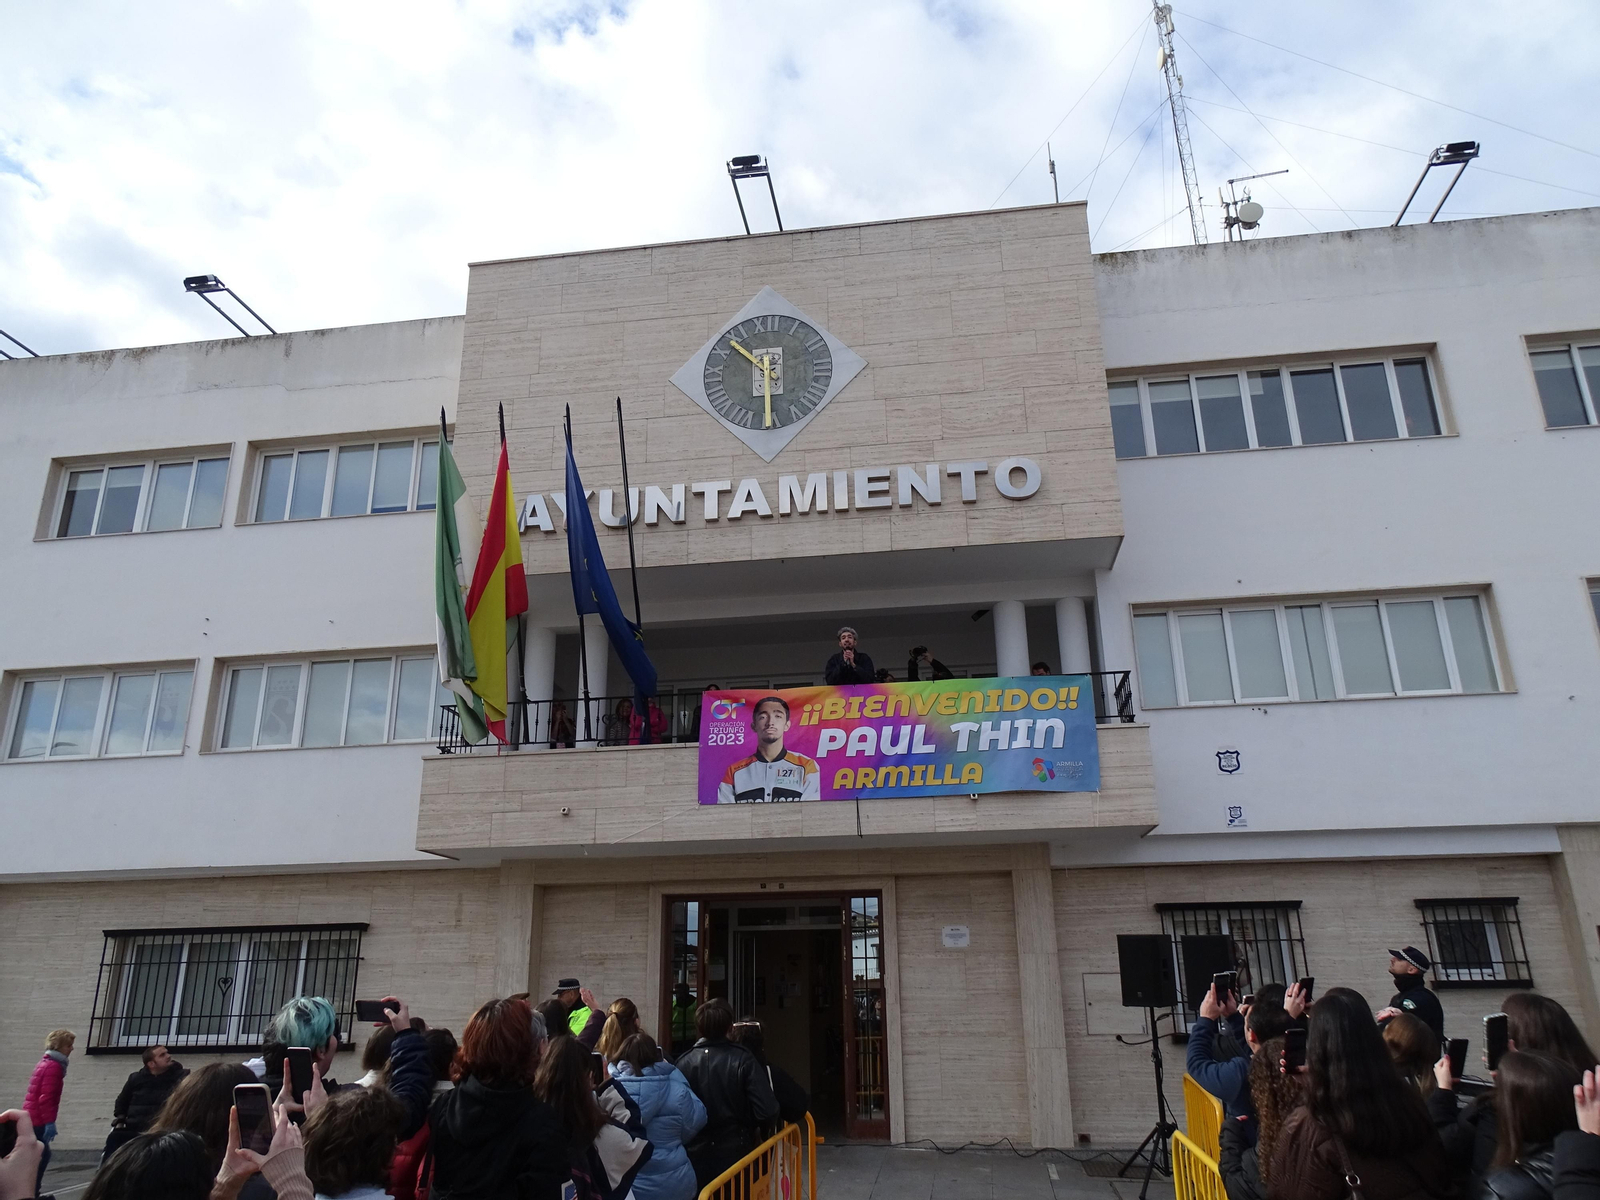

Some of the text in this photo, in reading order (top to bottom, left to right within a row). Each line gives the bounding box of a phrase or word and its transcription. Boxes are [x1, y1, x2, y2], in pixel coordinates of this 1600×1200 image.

[724, 324, 749, 343] XI
[752, 316, 780, 334] XII
[788, 320, 801, 335] I
[711, 345, 731, 360] X
[804, 335, 825, 353] II
[705, 364, 724, 383] IX
[812, 358, 832, 377] III
[709, 726, 745, 734] TRIUNFO
[816, 718, 1066, 758] PAUL THIN
[708, 733, 745, 746] 2023
[832, 762, 983, 790] ARMILLA
